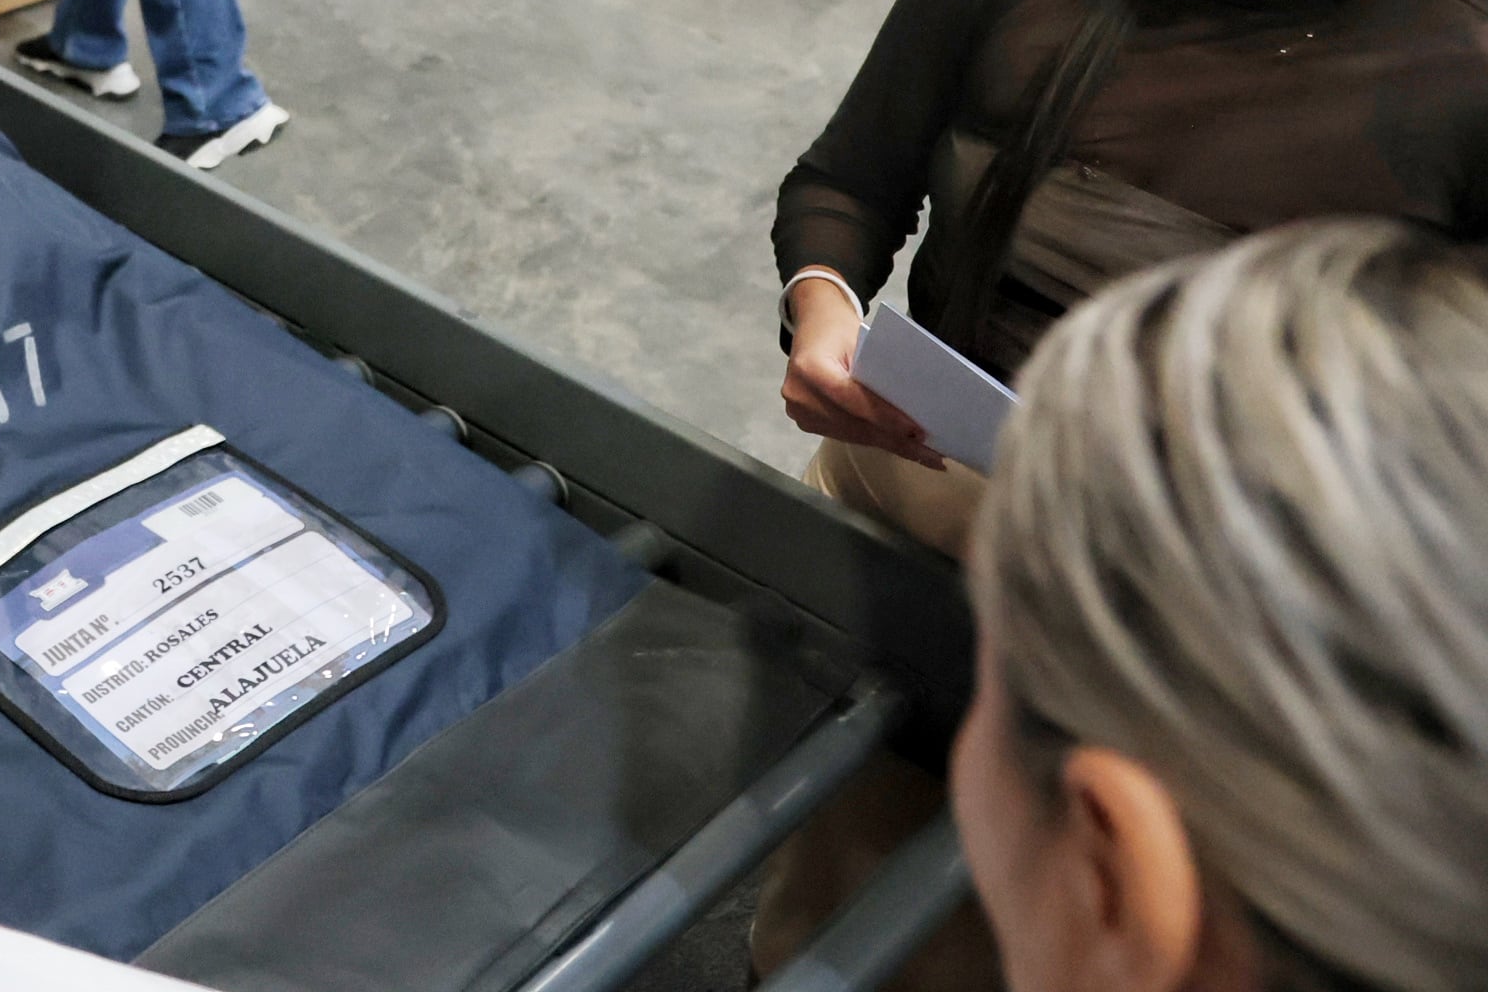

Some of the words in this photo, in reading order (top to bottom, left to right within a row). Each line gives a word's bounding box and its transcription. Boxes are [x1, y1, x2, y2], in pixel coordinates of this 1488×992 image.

[42, 624, 96, 667] JUNTA
[152, 556, 207, 594] 2537
[81, 659, 149, 705] DISTRITO:
[143, 608, 219, 663] ROSALES
[115, 693, 174, 733] CANTÓN:
[177, 623, 273, 689] CENTRAL
[208, 635, 327, 716] ALAJUELA
